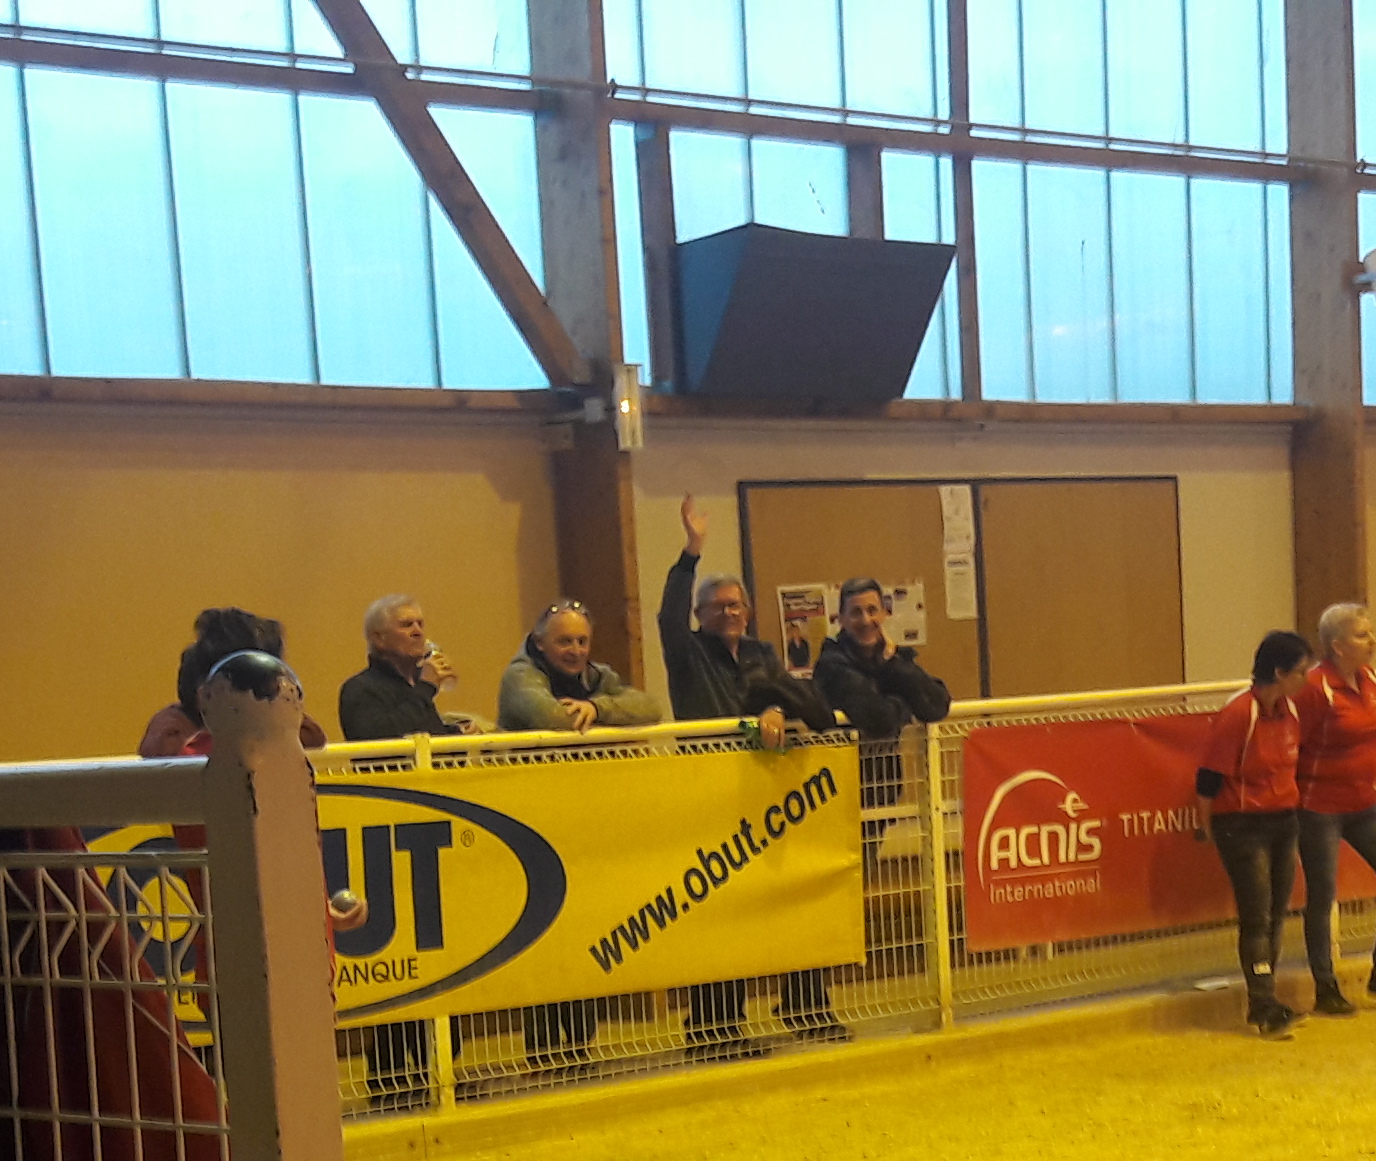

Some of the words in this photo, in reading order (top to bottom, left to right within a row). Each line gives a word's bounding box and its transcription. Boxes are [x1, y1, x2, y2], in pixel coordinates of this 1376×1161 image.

[589, 766, 838, 974] www.obut.com
[990, 819, 1102, 872] ACNIS
[990, 871, 1101, 905] International
